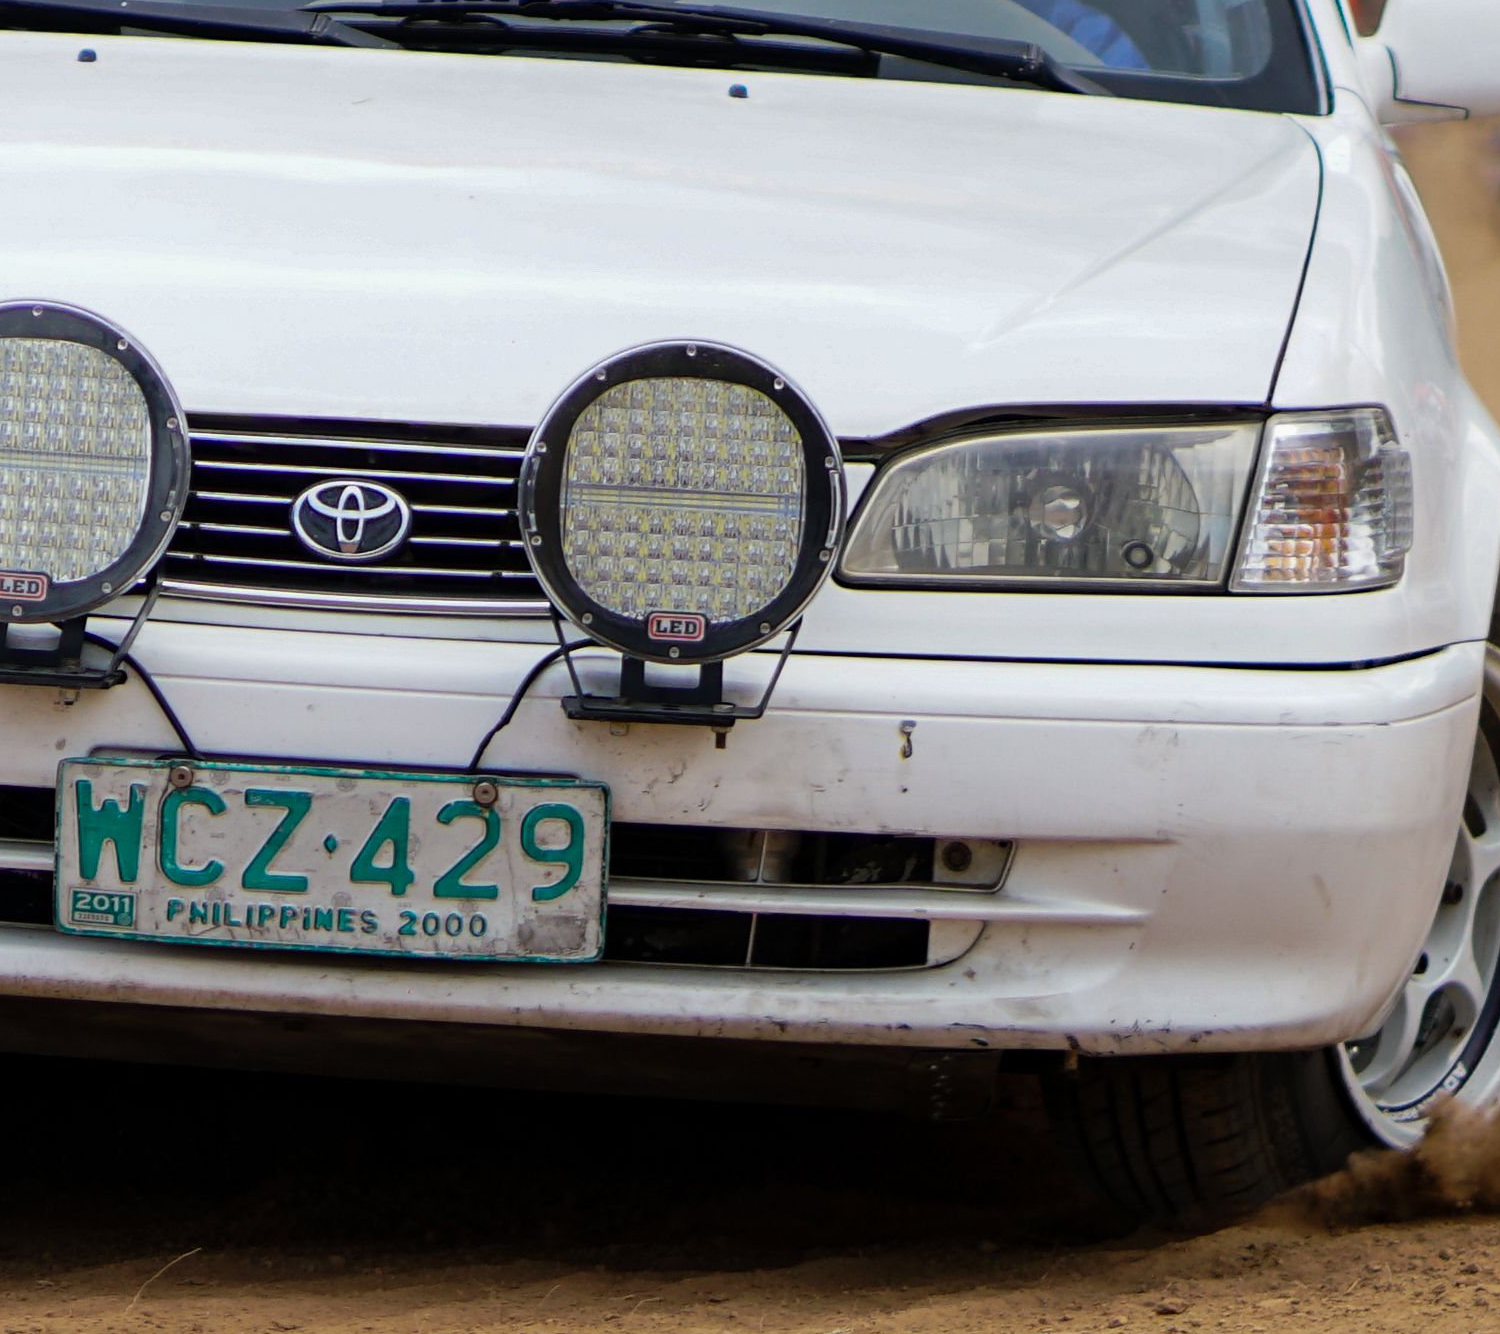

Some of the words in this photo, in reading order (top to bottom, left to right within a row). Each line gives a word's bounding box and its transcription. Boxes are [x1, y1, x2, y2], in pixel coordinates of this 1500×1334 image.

[655, 618, 698, 635] LED
[75, 893, 130, 913] 2011
[166, 897, 379, 934] PHILIPPINES
[398, 908, 489, 938] 2000
